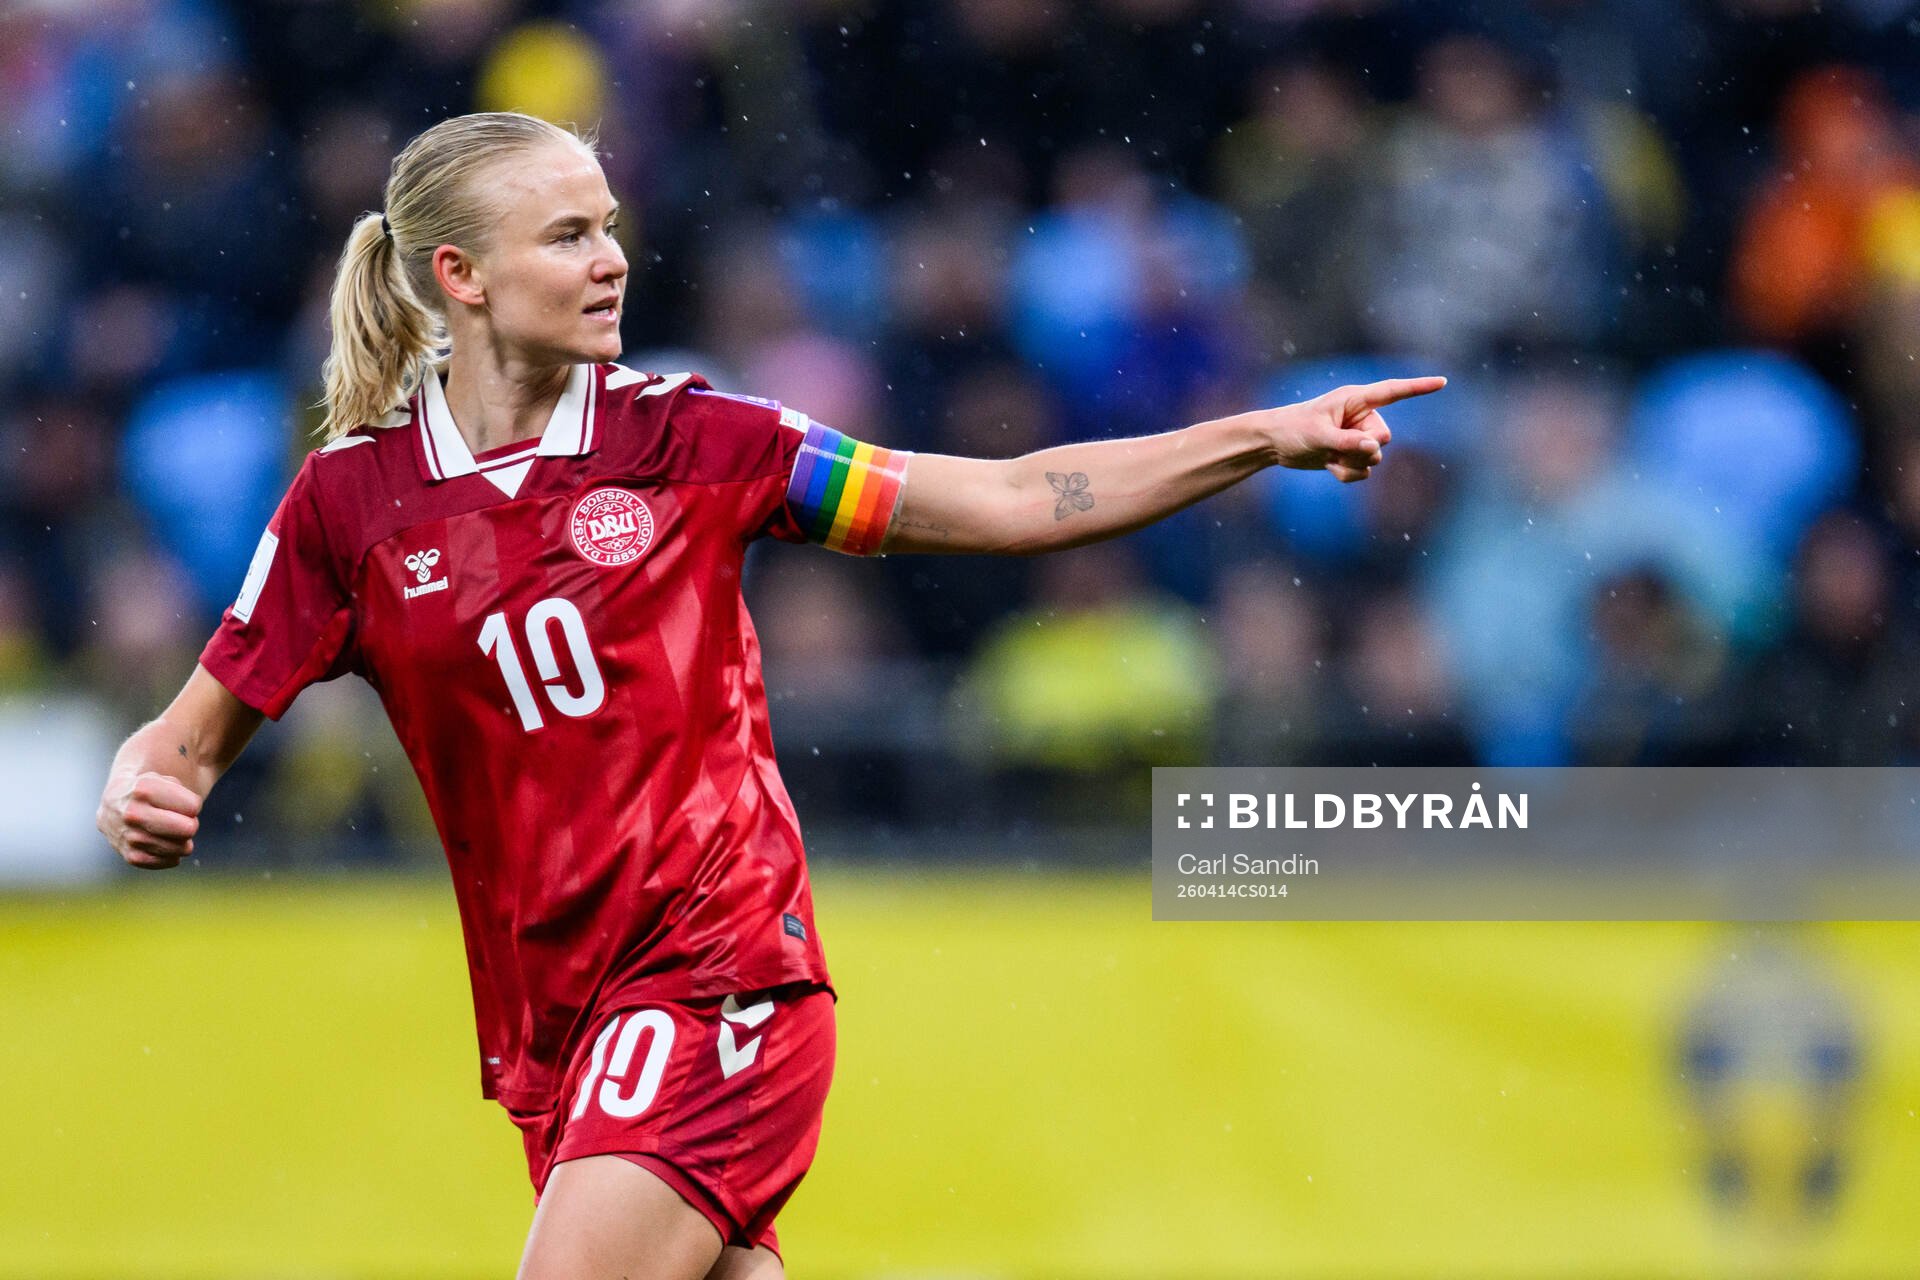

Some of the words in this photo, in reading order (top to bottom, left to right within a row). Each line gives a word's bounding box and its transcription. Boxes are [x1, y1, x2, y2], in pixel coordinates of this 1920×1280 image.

[575, 518, 600, 559] DANSK
[588, 511, 637, 541] DBU
[635, 506, 651, 547] UNION
[606, 548, 637, 563] 1889
[403, 576, 448, 600] hummel
[476, 597, 605, 732] 10
[571, 1009, 676, 1121] 10
